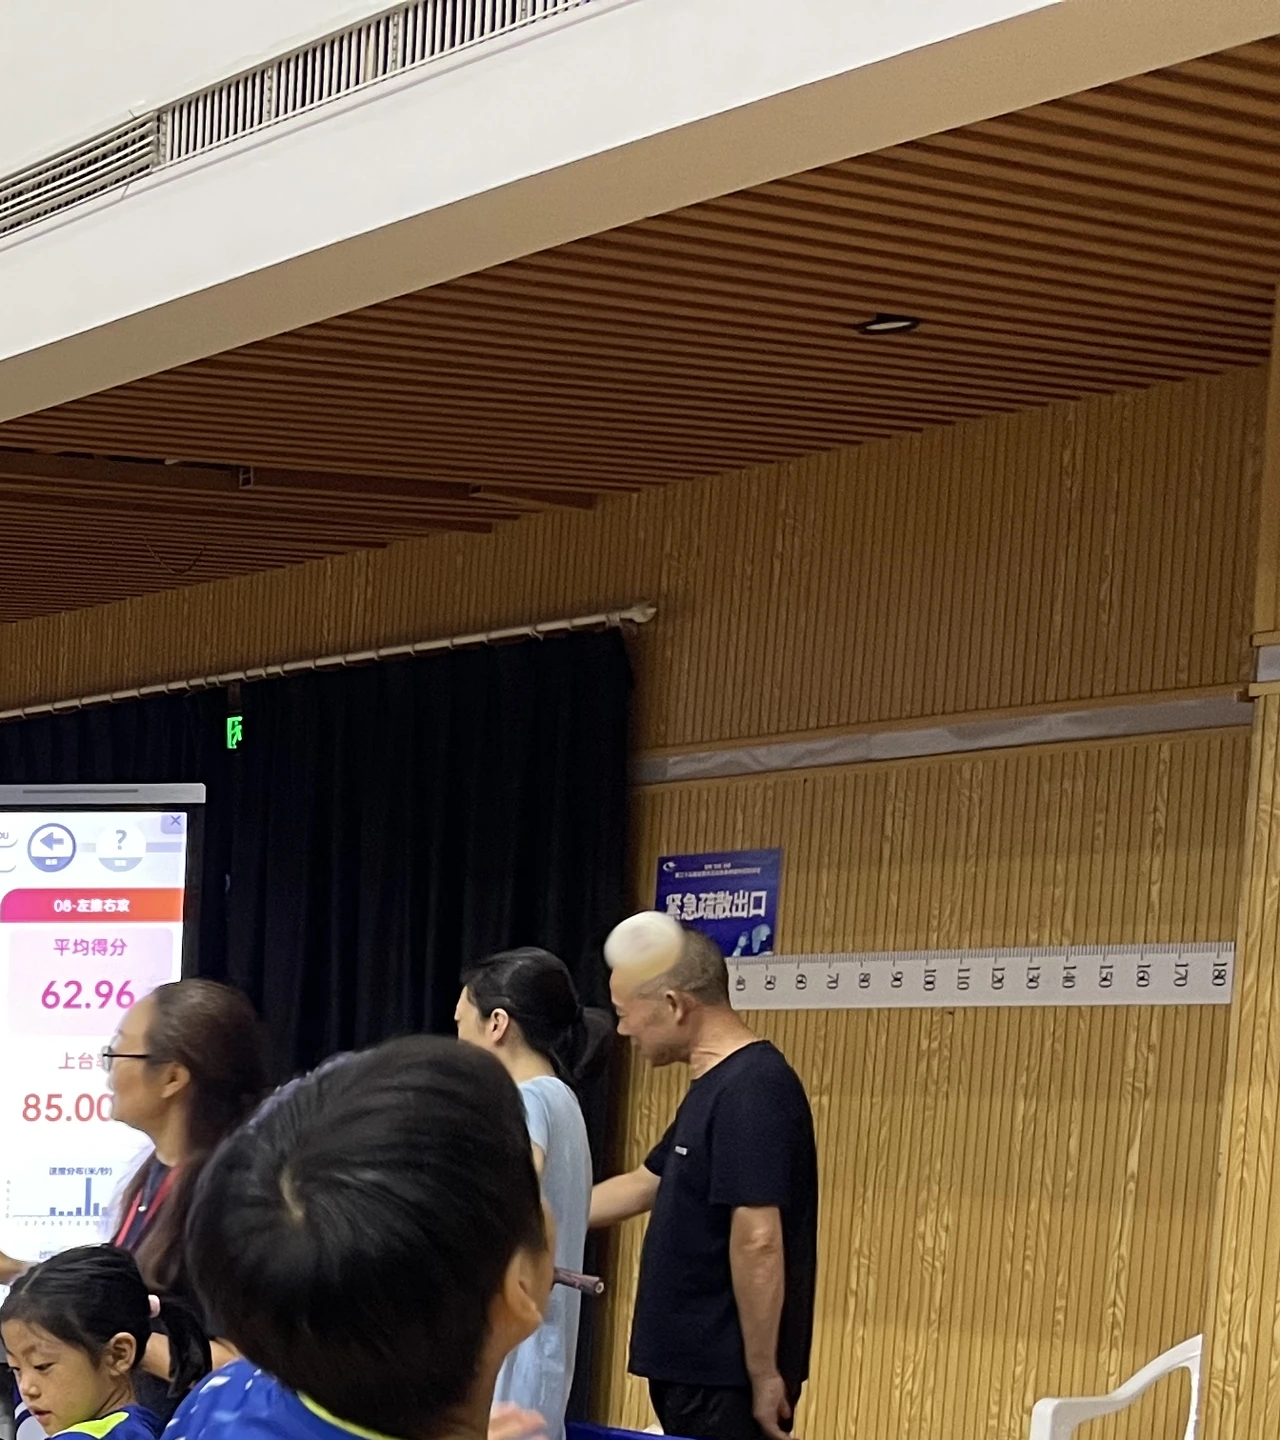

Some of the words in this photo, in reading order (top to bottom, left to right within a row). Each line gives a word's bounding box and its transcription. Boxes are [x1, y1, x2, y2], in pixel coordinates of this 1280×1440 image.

[666, 890, 767, 920] 紧急疏散出口
[53, 938, 128, 956] 平均得分
[795, 974, 807, 990] 60
[827, 973, 840, 990] 70
[858, 972, 871, 989] 80
[891, 971, 903, 988] 90
[923, 968, 937, 991] 100
[957, 968, 971, 991] 110
[991, 967, 1005, 990] 120
[1026, 966, 1040, 990] 130
[1062, 965, 1077, 988] 140
[1098, 964, 1113, 988] 150
[1136, 964, 1151, 988] 160
[1173, 962, 1189, 987] 170
[1212, 962, 1227, 987] 180
[41, 980, 135, 1009] 62.96
